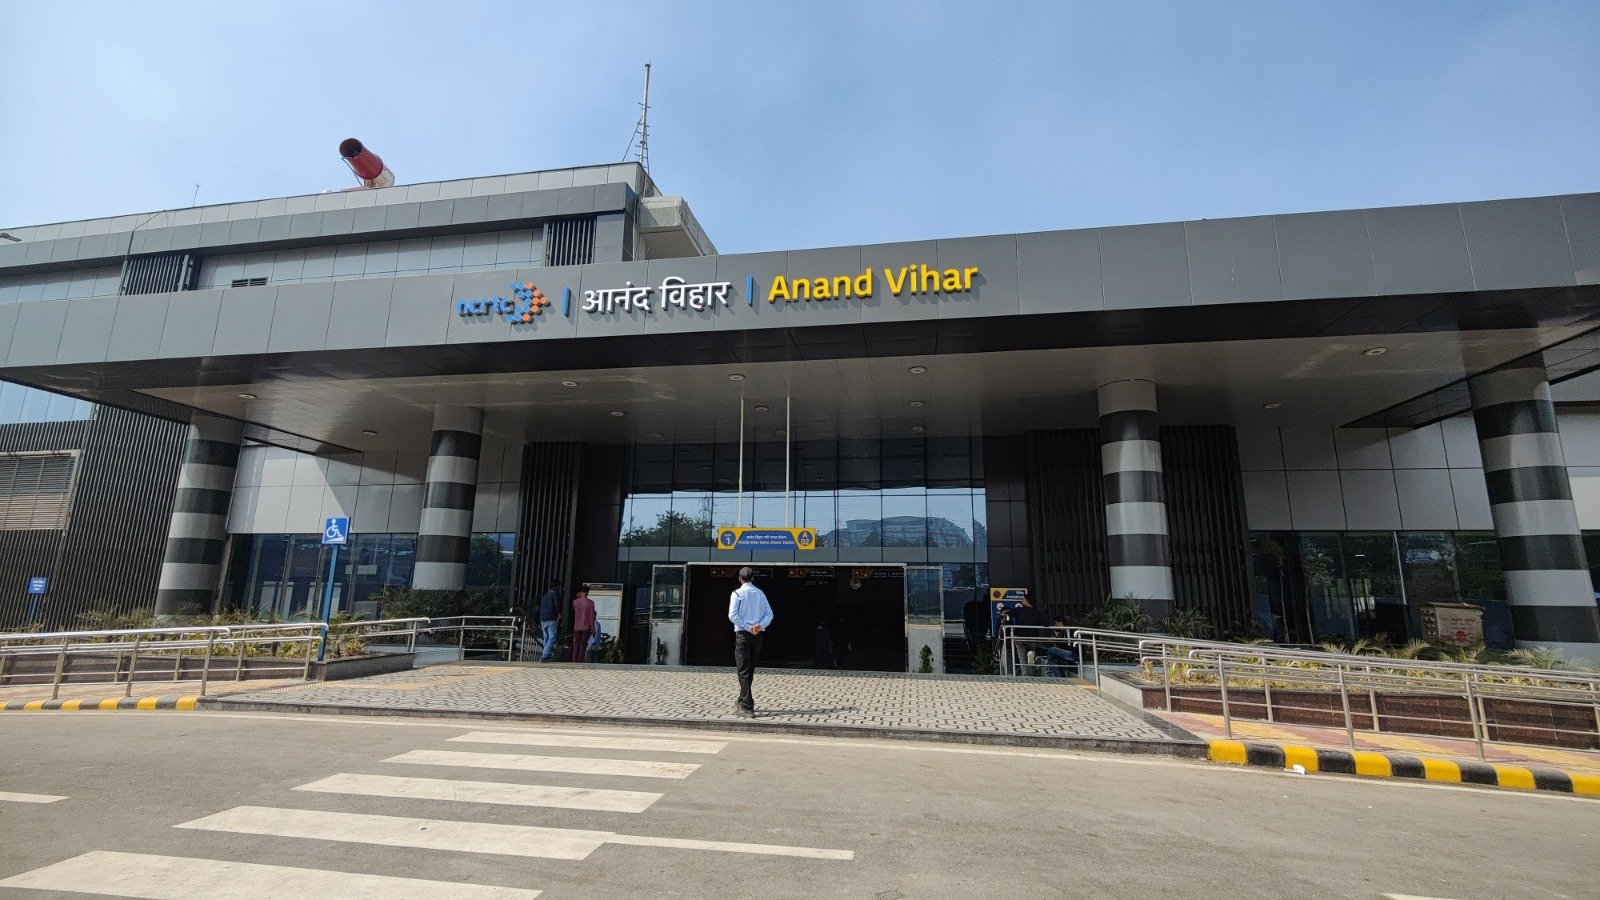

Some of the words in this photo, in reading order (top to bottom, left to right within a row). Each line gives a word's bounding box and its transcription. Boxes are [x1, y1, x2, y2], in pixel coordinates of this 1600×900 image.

[582, 281, 652, 313] आनंद
[659, 275, 731, 308] विहार
[767, 267, 873, 303] Anand
[884, 263, 979, 295] Vihar
[456, 295, 514, 316] ncrtc
[800, 538, 810, 546] 02
